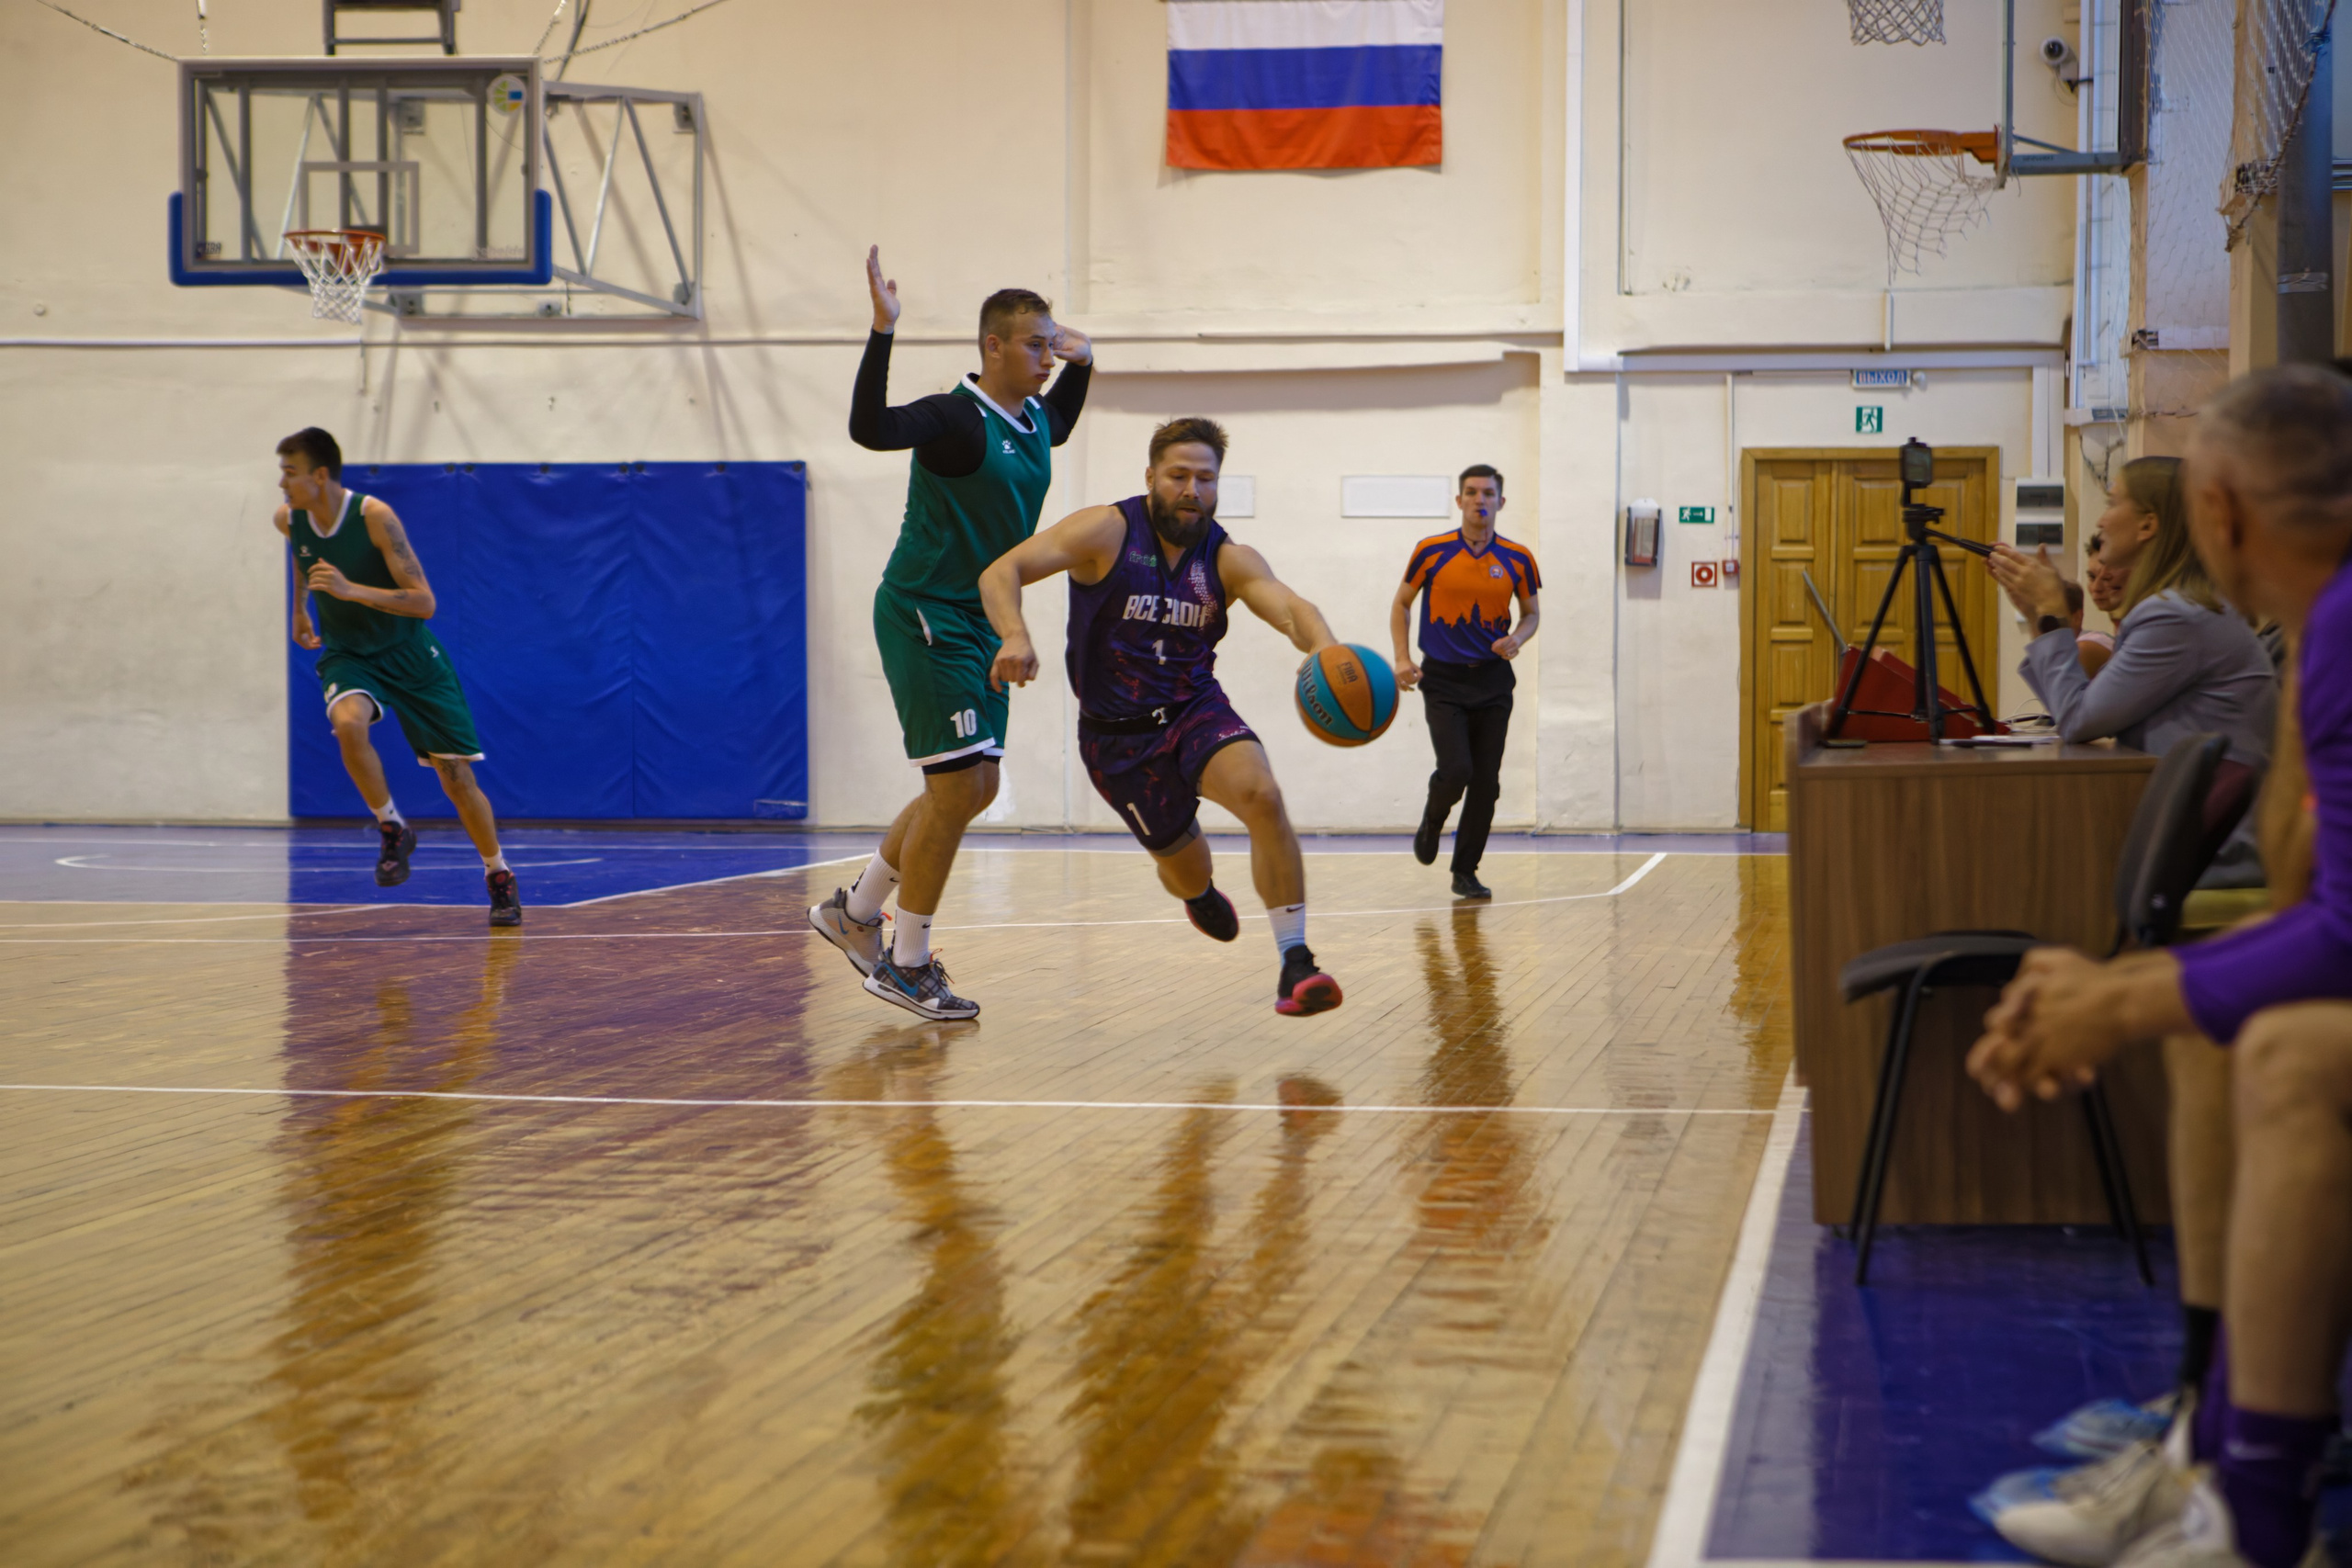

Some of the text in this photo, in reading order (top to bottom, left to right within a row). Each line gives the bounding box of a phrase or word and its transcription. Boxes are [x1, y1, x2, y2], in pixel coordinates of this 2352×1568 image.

[1152, 639, 1166, 665] 1
[1301, 661, 1332, 726] Wilson
[950, 708, 978, 739] 10
[1126, 802, 1151, 836] 1
